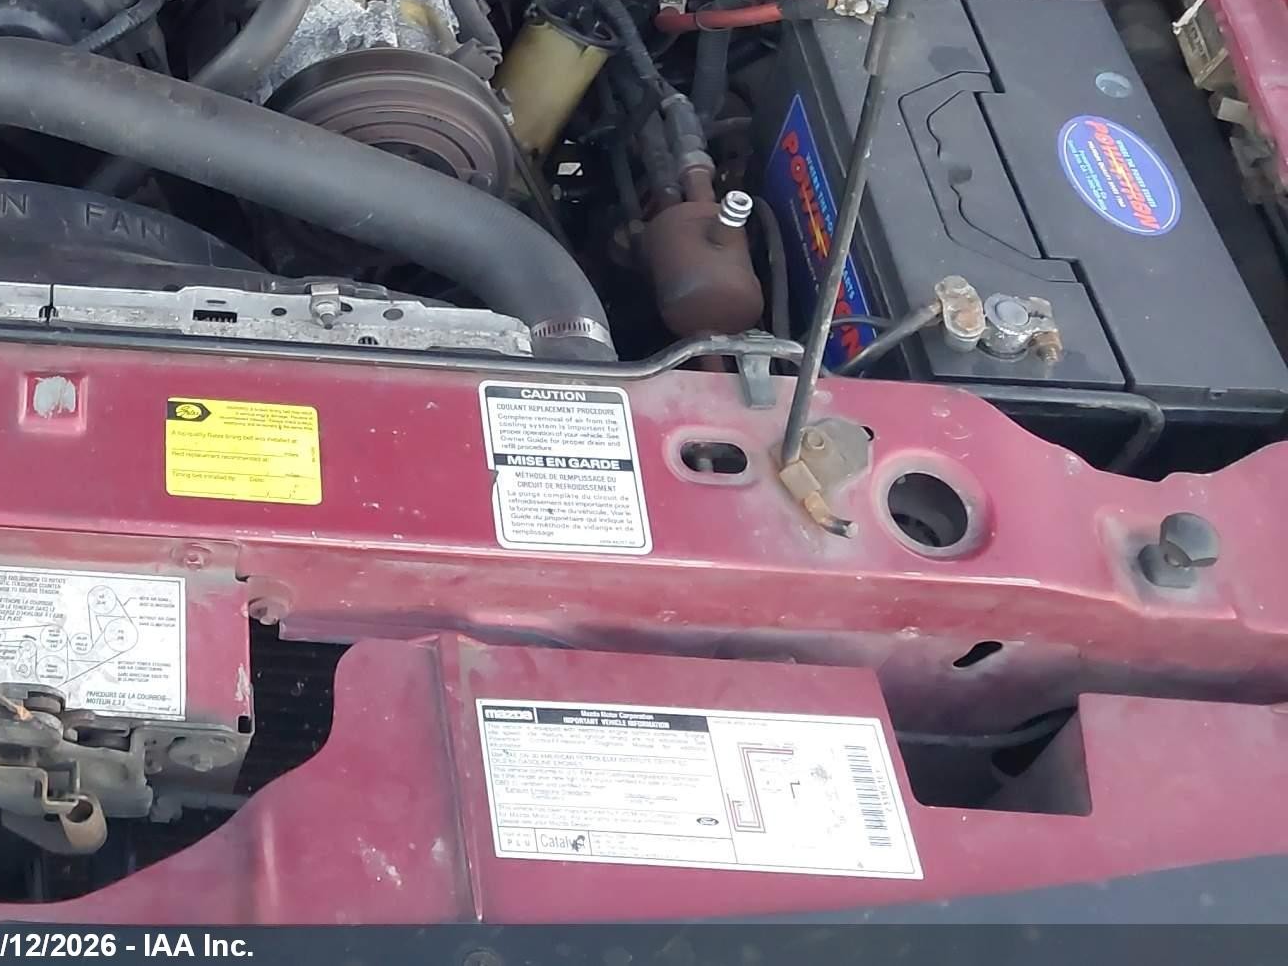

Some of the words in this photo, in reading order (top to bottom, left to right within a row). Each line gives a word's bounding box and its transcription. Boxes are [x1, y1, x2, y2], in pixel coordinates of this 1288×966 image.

[83, 202, 168, 243] FAN
[520, 389, 586, 401] CAUTION
[497, 403, 527, 412] COOLANT
[529, 405, 575, 415] REPLACEMENT
[577, 407, 615, 416] PROCEDURE
[498, 413, 532, 422] Complete
[499, 421, 526, 429] cooling
[567, 424, 605, 433] important
[527, 436, 548, 444] Guide
[562, 438, 585, 447] proper
[507, 456, 544, 467] MISE
[546, 457, 566, 468] EN
[568, 458, 621, 470] GARDE
[559, 474, 605, 482] REMPLISSAGE
[607, 475, 617, 483] DU
[517, 481, 543, 489] CIRCUIT
[556, 483, 617, 492] REFROIDISSEMENT
[563, 717, 599, 725] IMPORTANT
[619, 712, 654, 720] Corporation
